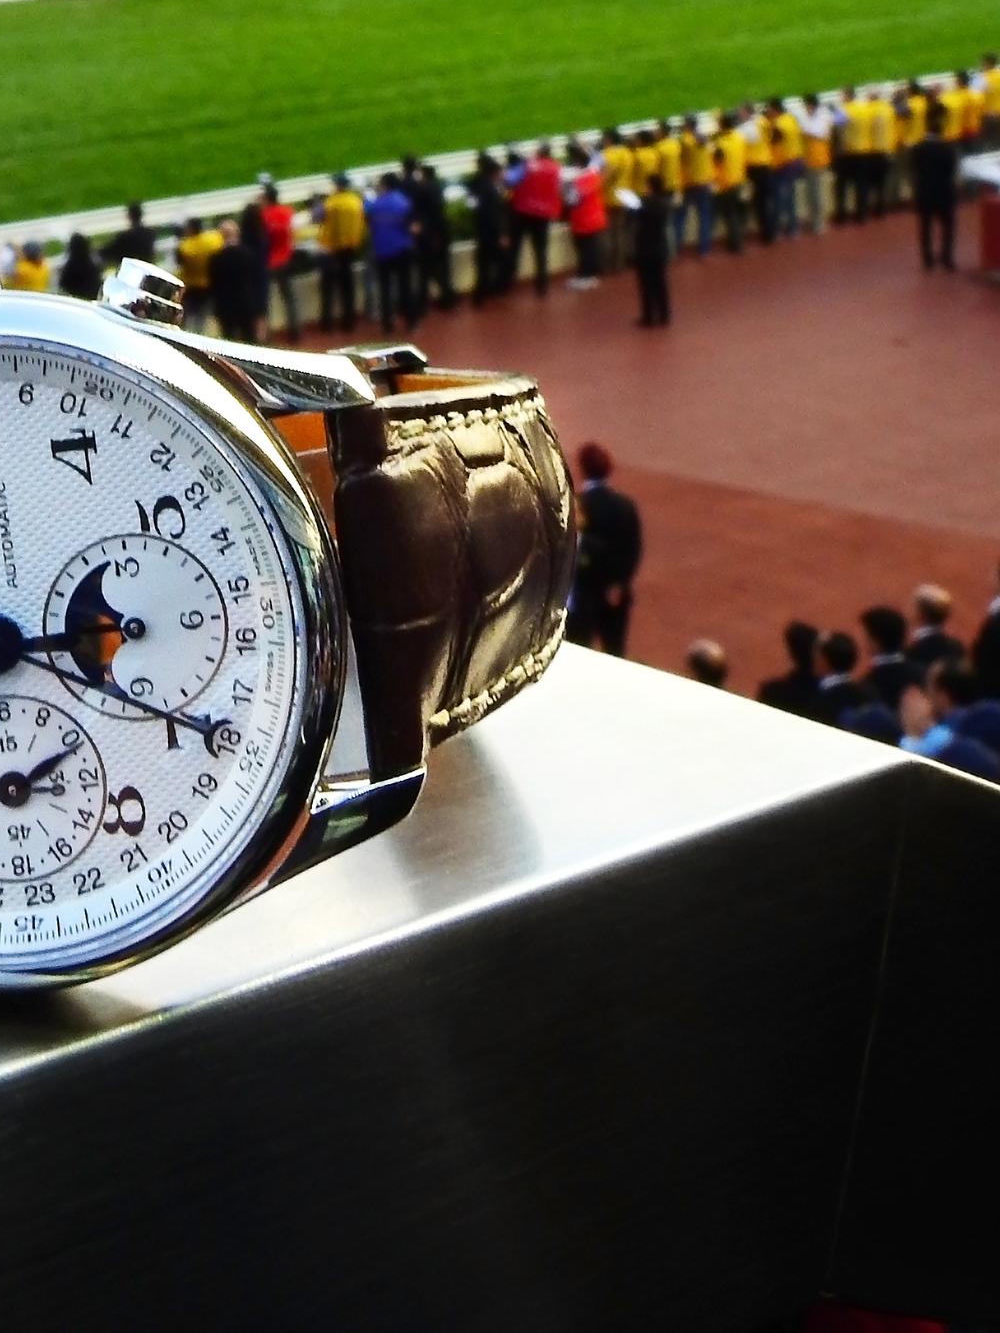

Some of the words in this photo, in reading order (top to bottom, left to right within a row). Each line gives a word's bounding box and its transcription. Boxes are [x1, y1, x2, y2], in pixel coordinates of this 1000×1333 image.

[60, 392, 87, 418] 10
[110, 414, 133, 438] 11
[50, 428, 98, 486] 4
[150, 442, 176, 472] 12
[199, 465, 223, 493] 25
[185, 481, 209, 511] 13
[135, 495, 186, 540] 5
[210, 526, 236, 556] 14
[114, 556, 140, 578] 3
[228, 576, 252, 604] 15
[179, 610, 204, 630] 6
[259, 597, 276, 630] 30
[236, 627, 257, 656] 16
[130, 677, 154, 697] 9
[232, 678, 253, 706] 17
[35, 707, 51, 727] 8
[217, 728, 241, 754] 18
[78, 767, 99, 792] 12
[192, 773, 218, 800] 19
[72, 808, 95, 831] 14
[102, 785, 146, 837] 8
[7, 824, 32, 840] 45
[157, 810, 188, 844] 20
[47, 838, 73, 863] 16
[120, 843, 149, 873] 21
[11, 854, 35, 877] 18
[24, 882, 56, 907] 23
[73, 867, 106, 896] 22
